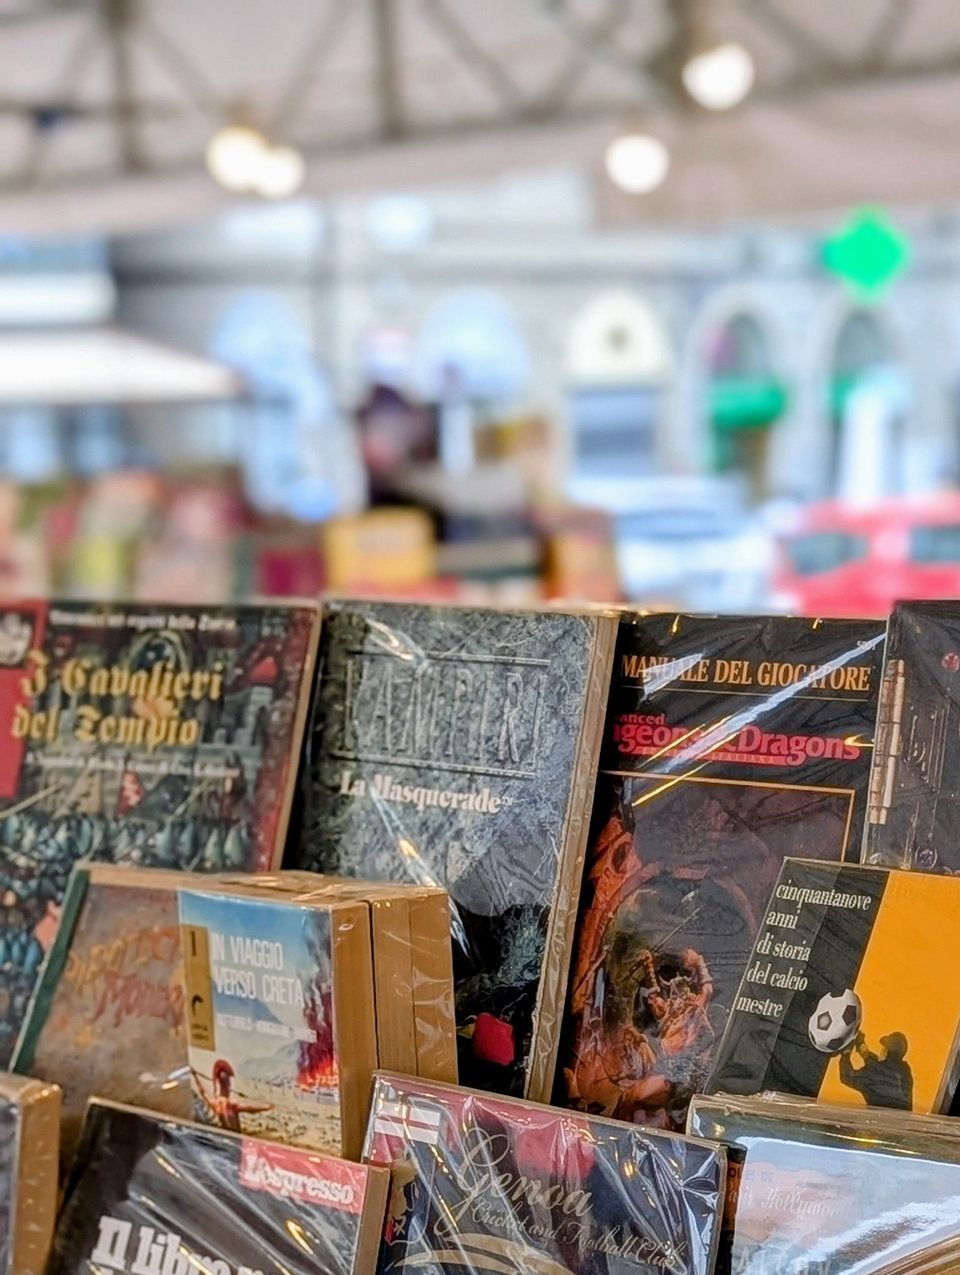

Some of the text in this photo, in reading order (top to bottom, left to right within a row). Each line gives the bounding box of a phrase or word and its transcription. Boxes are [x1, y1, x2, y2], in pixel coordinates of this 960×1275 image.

[61, 657, 225, 701] Cavalieri
[623, 653, 872, 692] MANUALE DEL GIOCATORE
[11, 703, 202, 751] del Tempio
[739, 724, 861, 768] Dragons
[339, 769, 366, 798] La
[775, 879, 872, 911] cinquantanove
[766, 909, 800, 930] anni
[211, 933, 283, 970] IN VIAGGIO
[756, 932, 812, 962] di storia
[213, 966, 306, 1008] VERSO CRETA
[747, 961, 809, 992] del calcio
[737, 996, 783, 1018] mestre
[433, 1128, 594, 1236] Genoa
[91, 1215, 134, 1271] Il
[528, 1217, 564, 1248] and
[562, 1220, 637, 1260] Football
